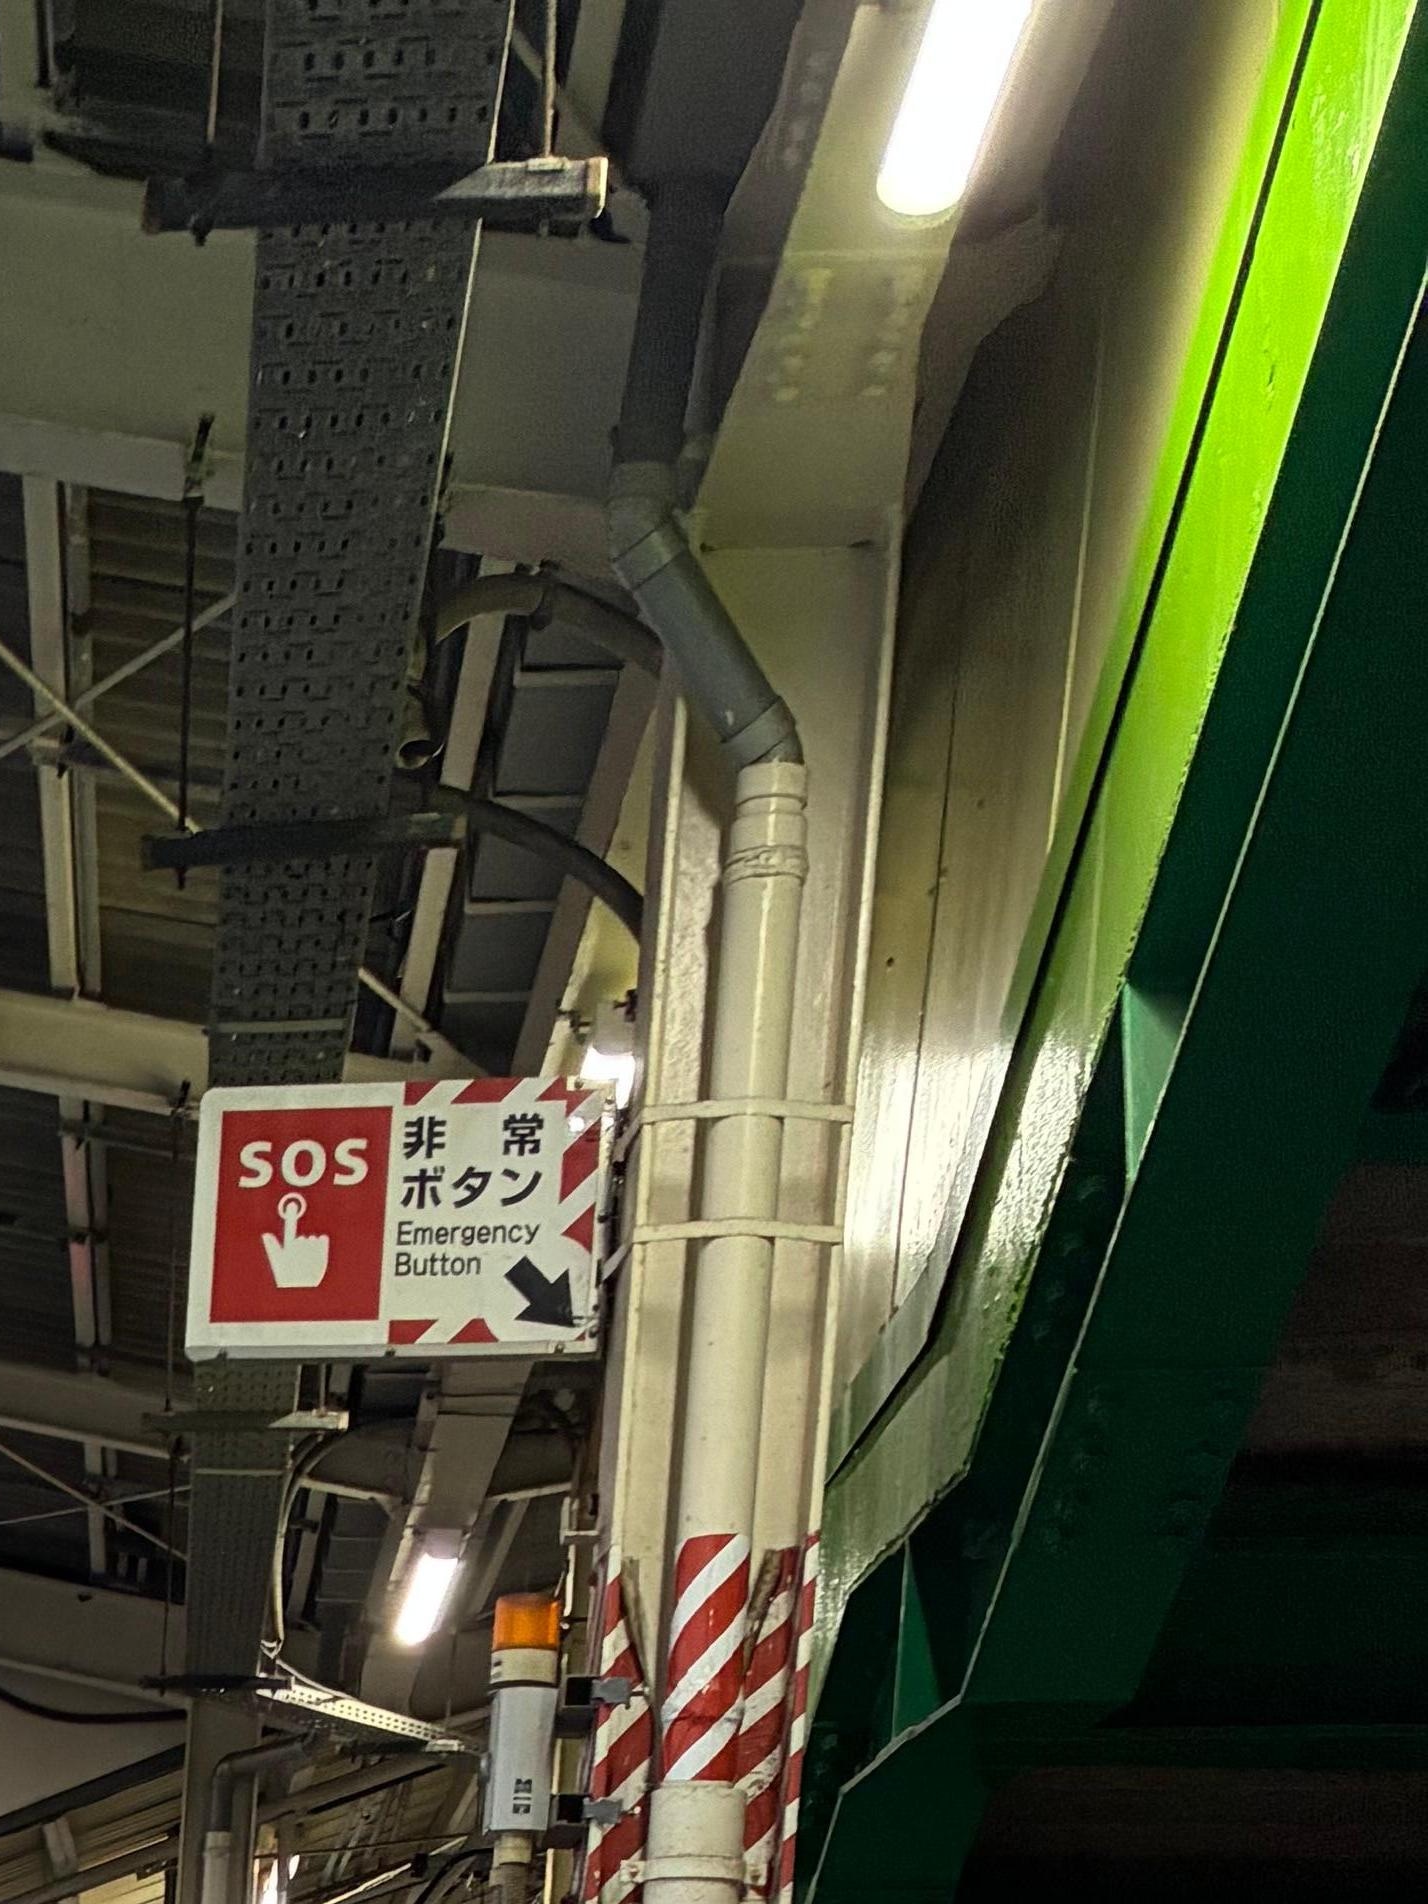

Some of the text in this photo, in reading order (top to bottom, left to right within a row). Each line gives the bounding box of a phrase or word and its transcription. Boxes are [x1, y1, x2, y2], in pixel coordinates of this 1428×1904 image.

[403, 1112, 544, 1159] 非常
[238, 1137, 369, 1188] SOS
[400, 1165, 542, 1210] ボタン
[396, 1220, 540, 1247] Emergency
[394, 1252, 482, 1277] Button
